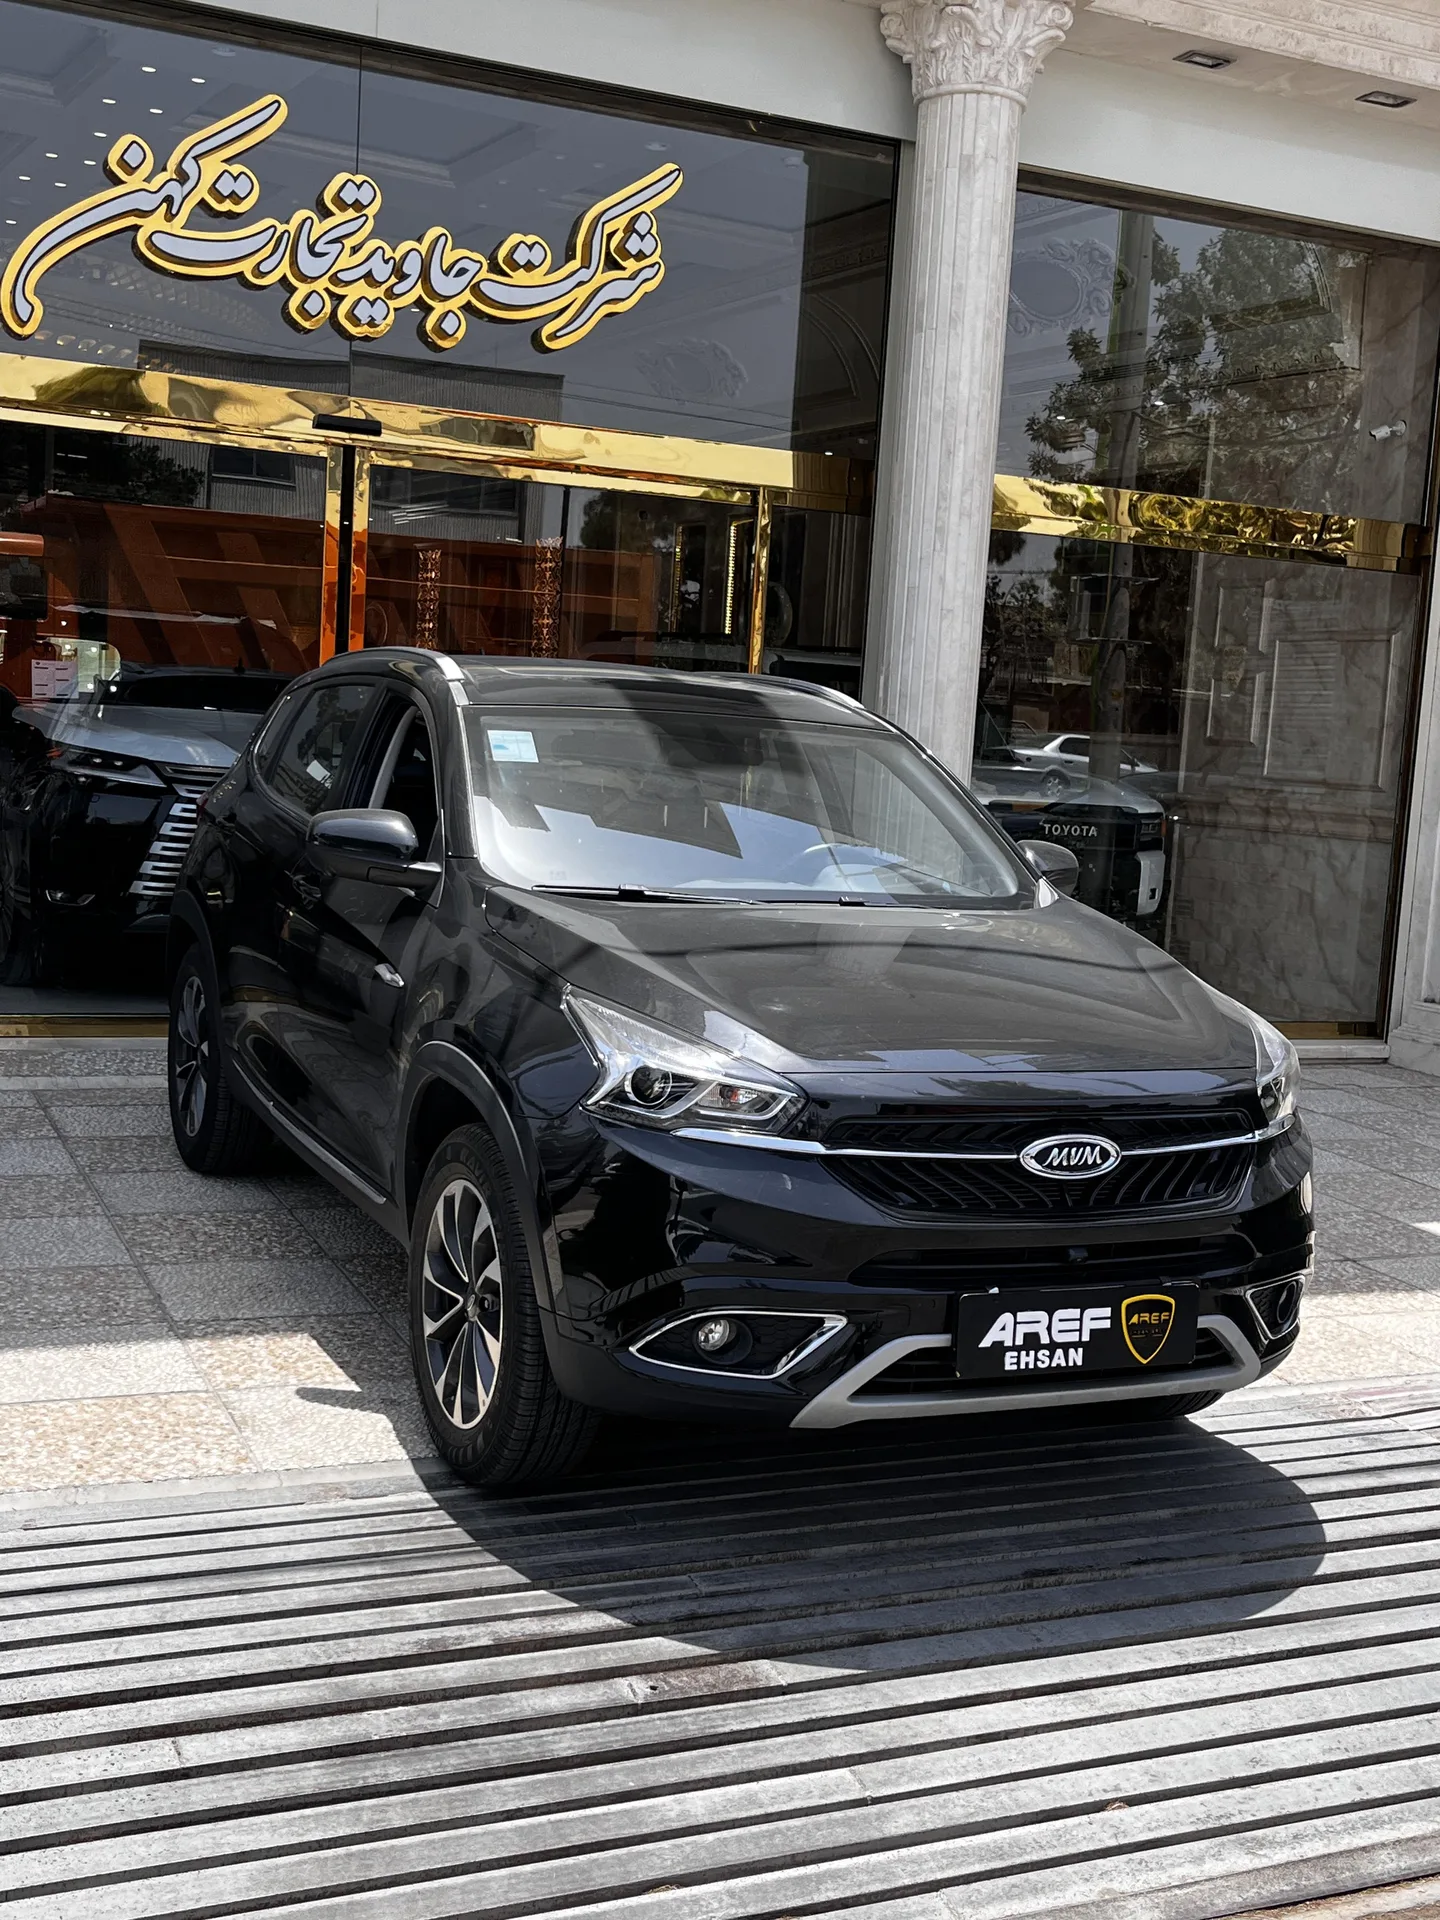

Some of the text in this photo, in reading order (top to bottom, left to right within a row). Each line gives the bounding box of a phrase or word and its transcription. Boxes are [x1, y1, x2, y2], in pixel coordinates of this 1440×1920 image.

[2, 95, 685, 353] شرکت جاوید تجارت کهن
[1043, 823, 1098, 837] TOYOTA
[1043, 1146, 1103, 1167] MVM
[978, 1306, 1112, 1348] AREF
[1128, 1311, 1170, 1326] AREF
[1004, 1347, 1084, 1371] EHSAN
